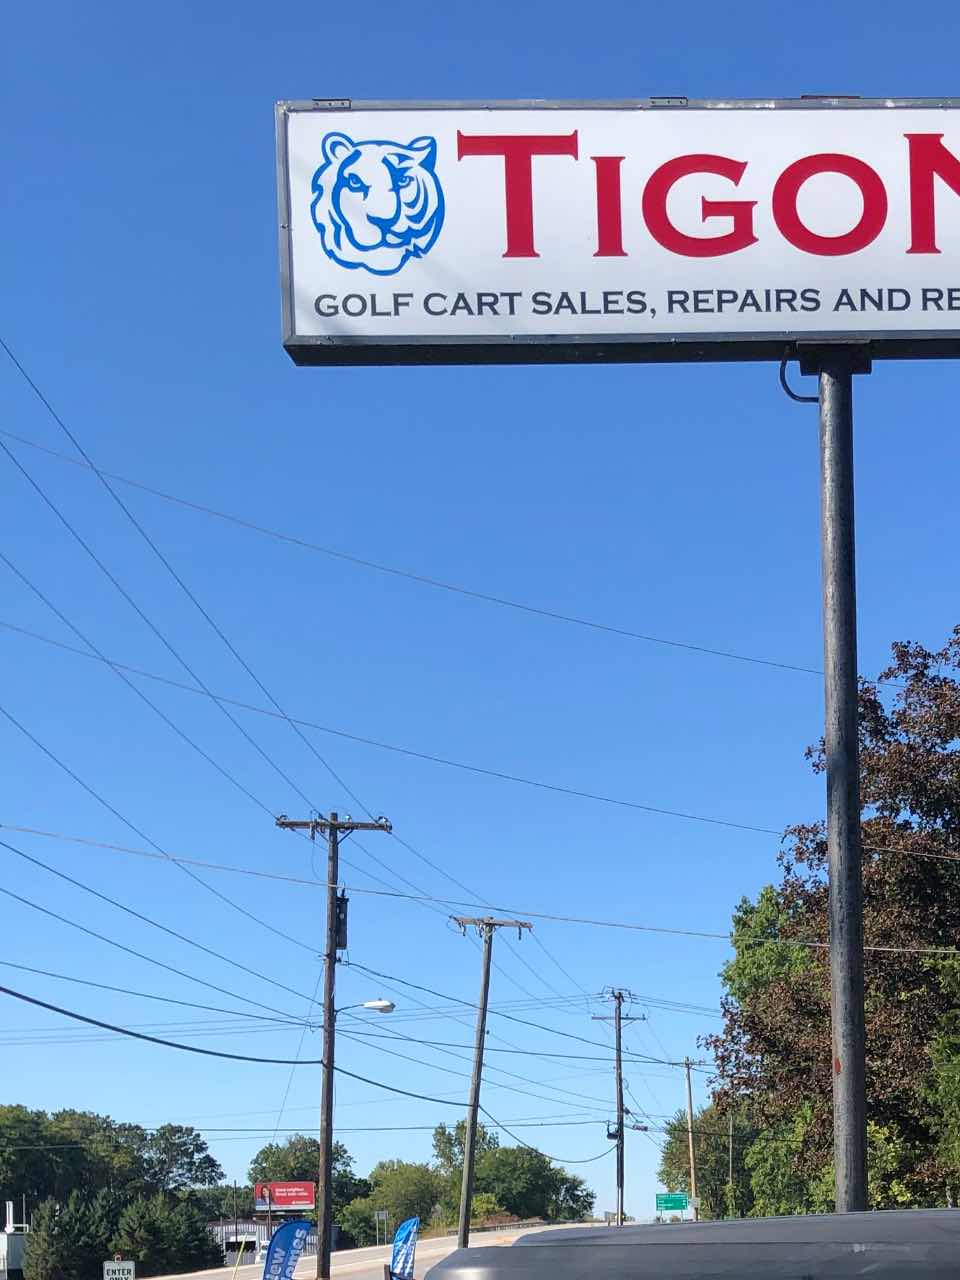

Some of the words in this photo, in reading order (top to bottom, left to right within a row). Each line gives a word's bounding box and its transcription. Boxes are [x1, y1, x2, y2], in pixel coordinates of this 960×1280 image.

[314, 292, 413, 317] GOLF
[423, 292, 522, 316] CART
[531, 290, 657, 319] SALES,
[667, 288, 820, 313] REPAIRS
[833, 287, 911, 312] AND
[106, 1268, 131, 1276] ENTER
